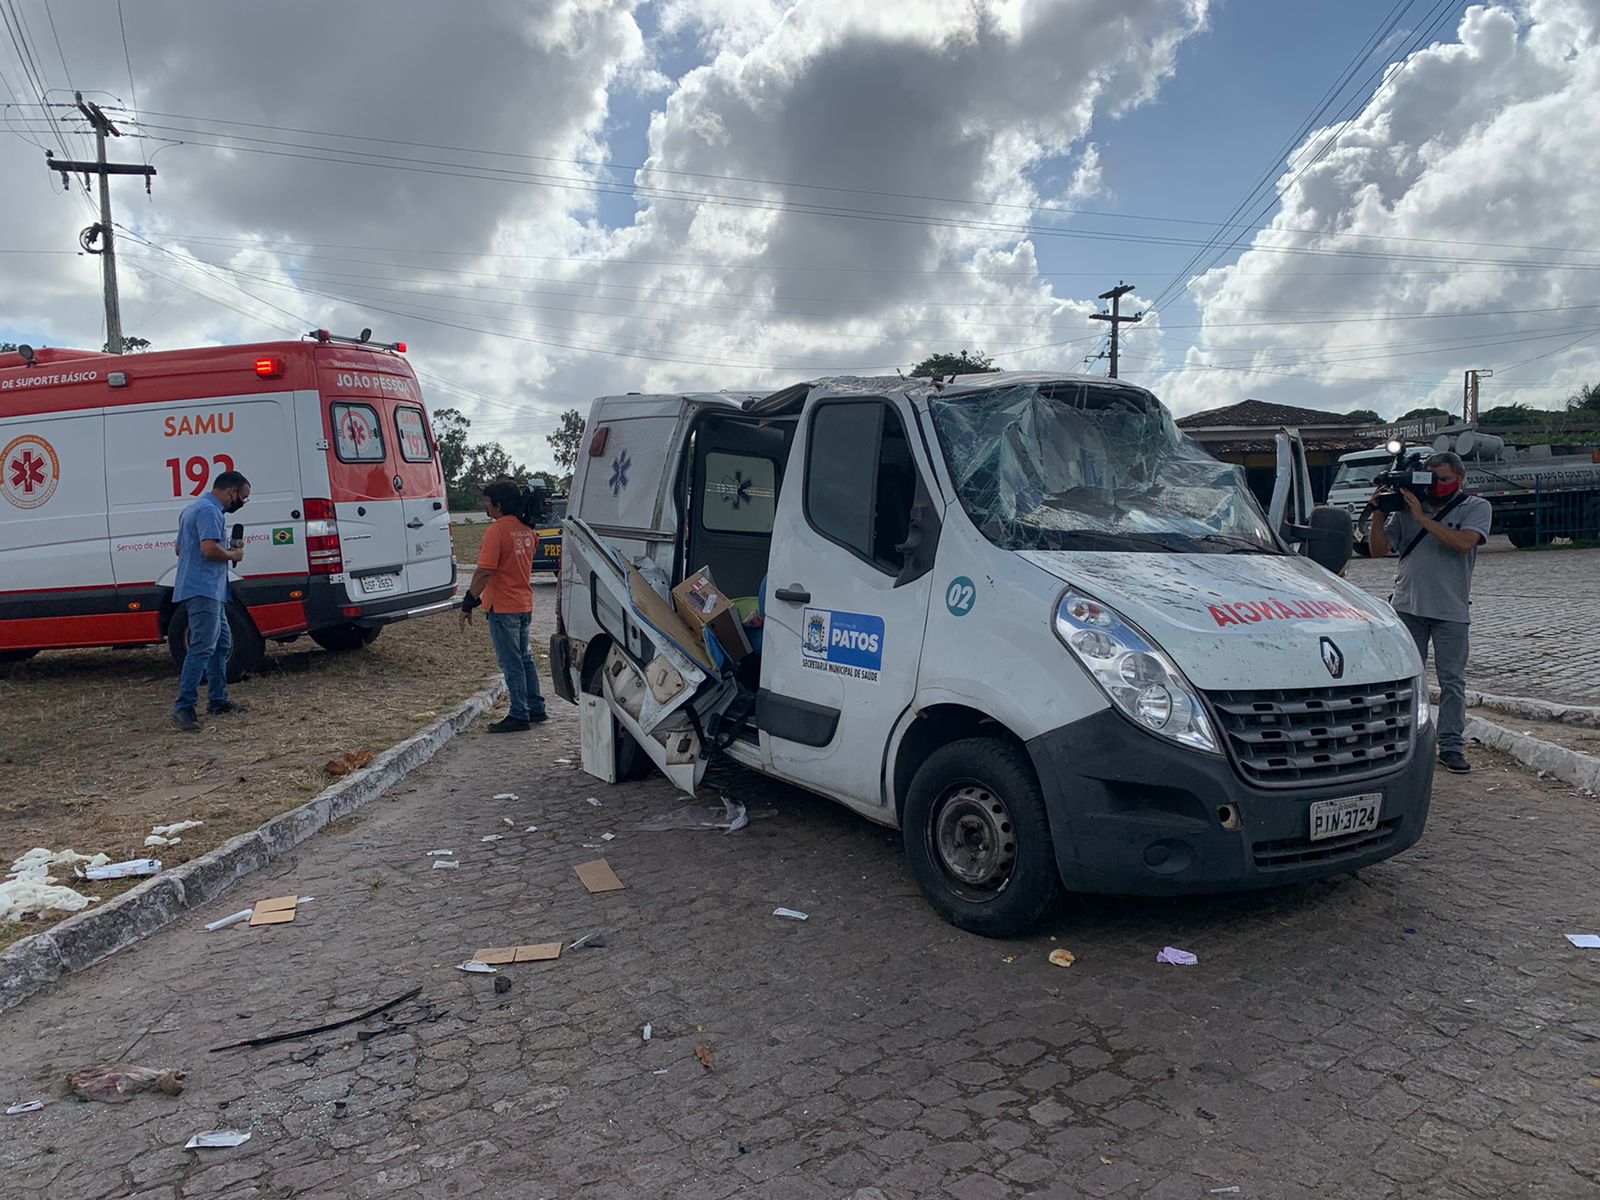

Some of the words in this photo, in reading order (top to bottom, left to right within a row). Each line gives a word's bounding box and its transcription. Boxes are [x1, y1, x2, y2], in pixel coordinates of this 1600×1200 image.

[1, 380, 14, 389] DE
[16, 375, 60, 388] SUPORTE
[61, 371, 97, 383] BÁSICO
[336, 371, 371, 388] JOÃO
[372, 376, 411, 393] PESSOA
[164, 412, 234, 437] SAMU
[116, 543, 142, 551] Serviço
[144, 541, 152, 549] de
[244, 533, 270, 544] rgência
[544, 544, 561, 556] PRF
[949, 583, 974, 610] 02
[832, 628, 879, 653] PATOS
[802, 659, 828, 672] SECRETARIA
[828, 664, 853, 677] MUNICIPAL
[854, 669, 861, 678] DE
[861, 669, 878, 682] SAÚDE
